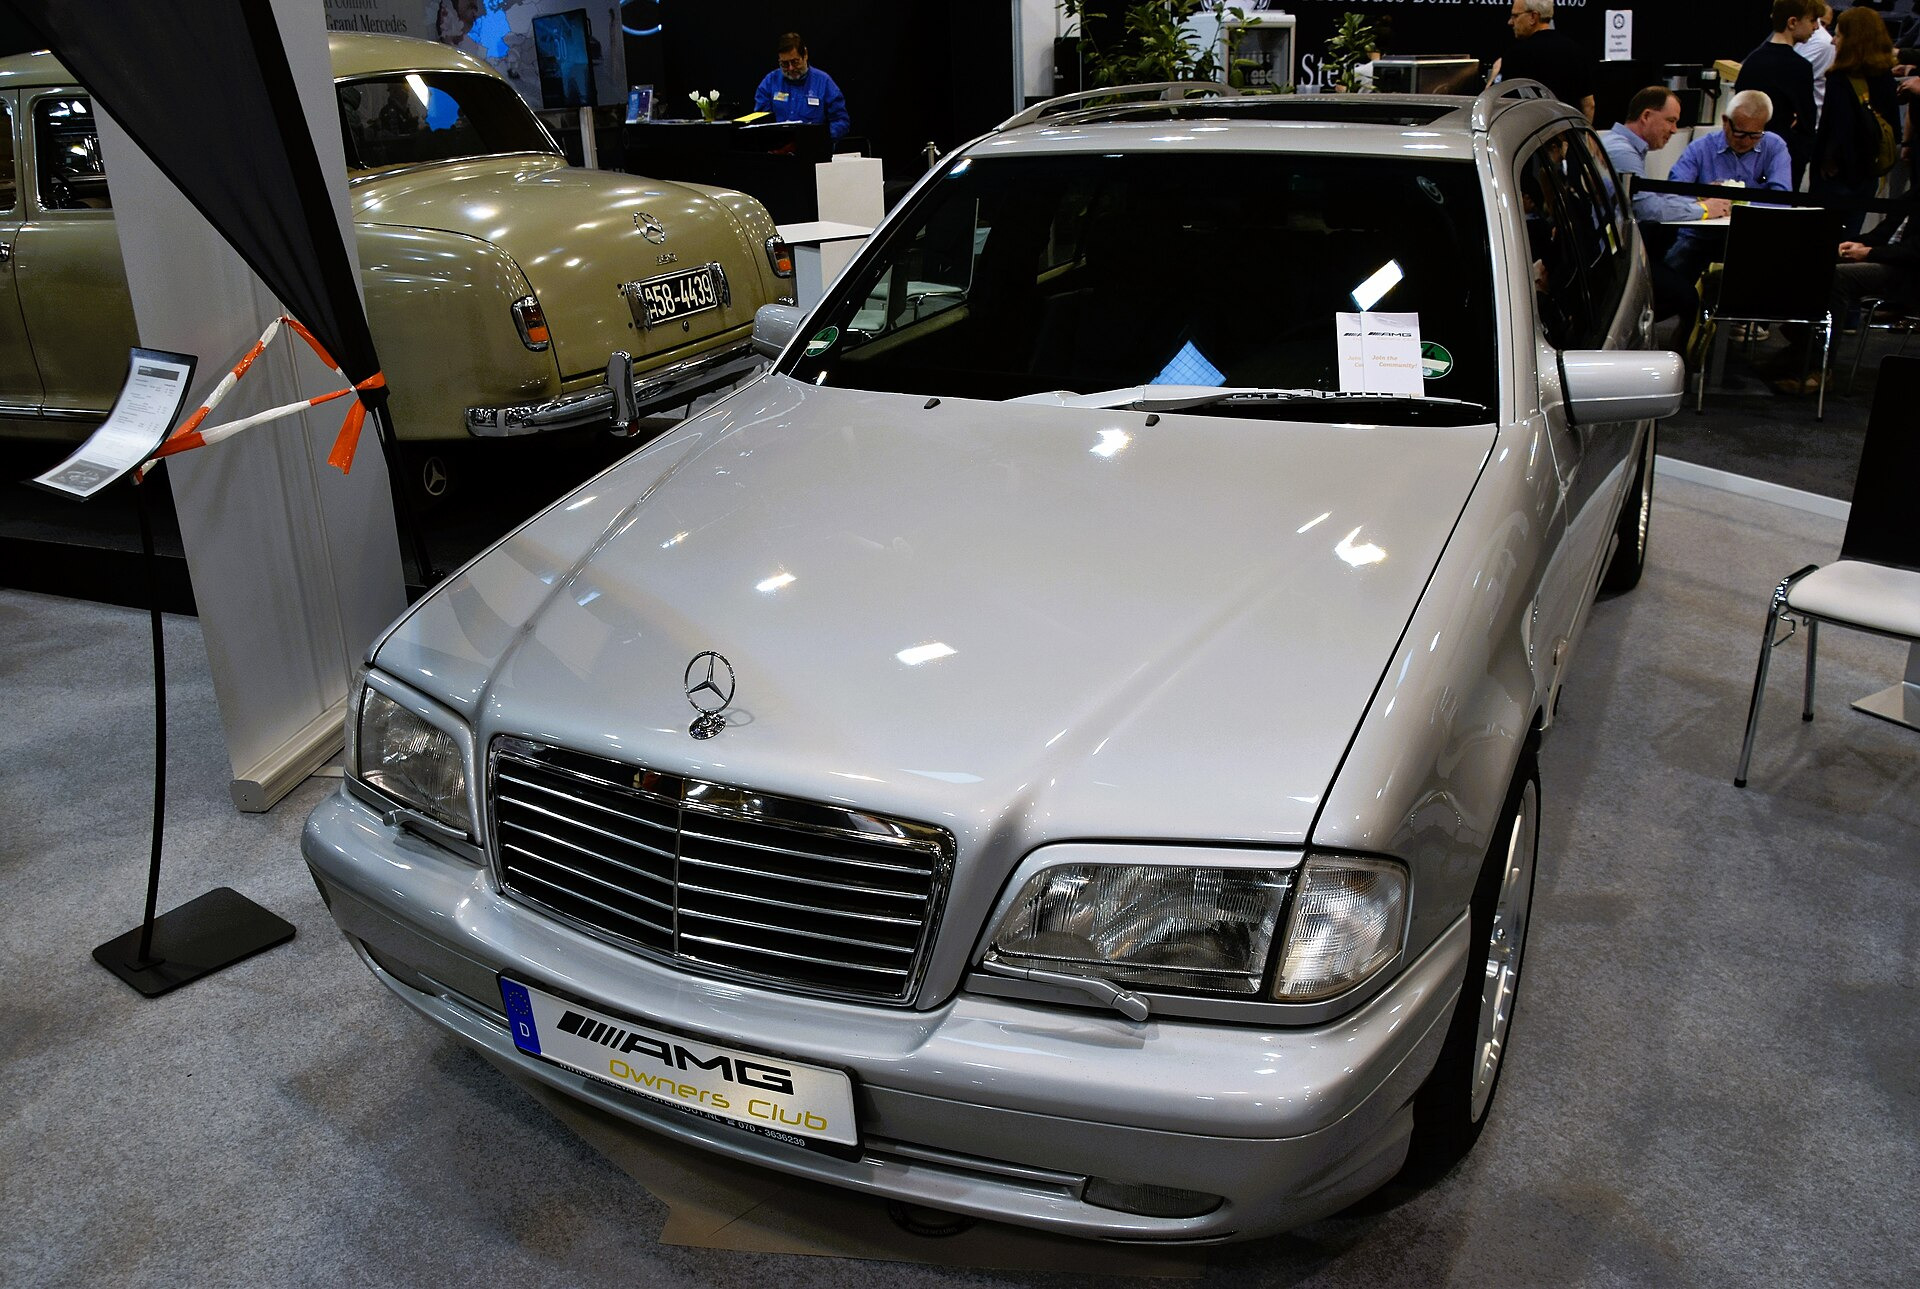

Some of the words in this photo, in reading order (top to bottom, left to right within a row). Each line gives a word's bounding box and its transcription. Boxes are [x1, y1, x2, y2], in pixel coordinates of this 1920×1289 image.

[326, 14, 358, 31] Grand
[360, 14, 408, 33] Mercedes
[1379, 361, 1418, 370] Community!
[519, 1022, 530, 1038] D
[619, 1032, 794, 1096] AMG
[609, 1059, 730, 1109] Owners
[747, 1099, 828, 1131] Club
[738, 1120, 756, 1133] 070
[764, 1126, 806, 1148] 3636239
